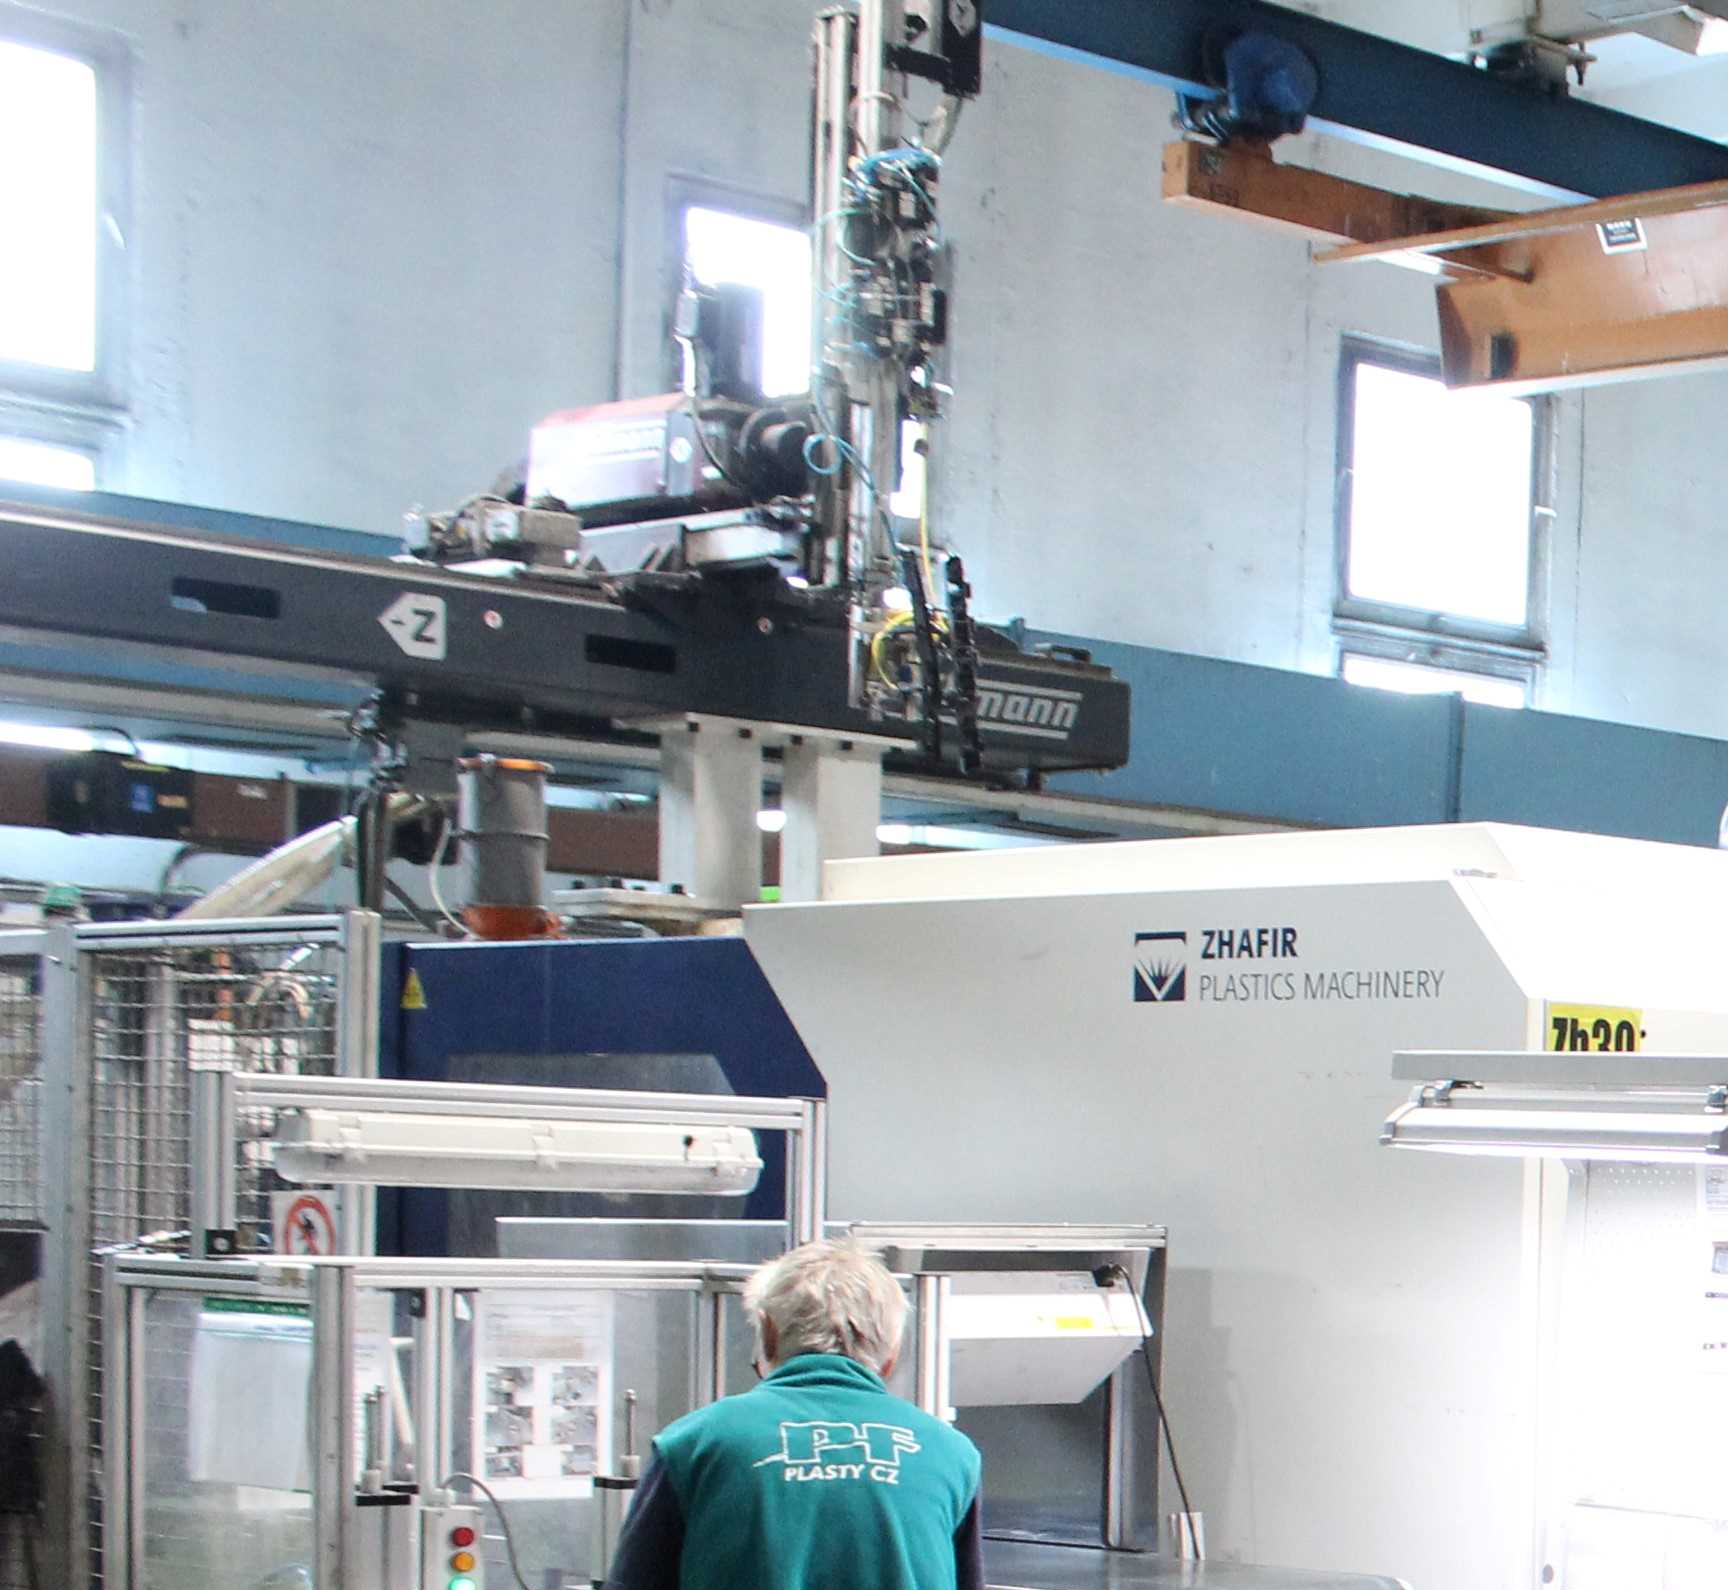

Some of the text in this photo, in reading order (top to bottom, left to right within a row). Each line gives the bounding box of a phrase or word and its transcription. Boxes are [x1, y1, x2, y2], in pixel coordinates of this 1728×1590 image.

[977, 689, 1079, 728] mann
[1201, 928, 1298, 959] ZHAFIR
[1200, 970, 1445, 1001] PLASTICS MACHINERY
[784, 1464, 899, 1484] PLASTY CZ
